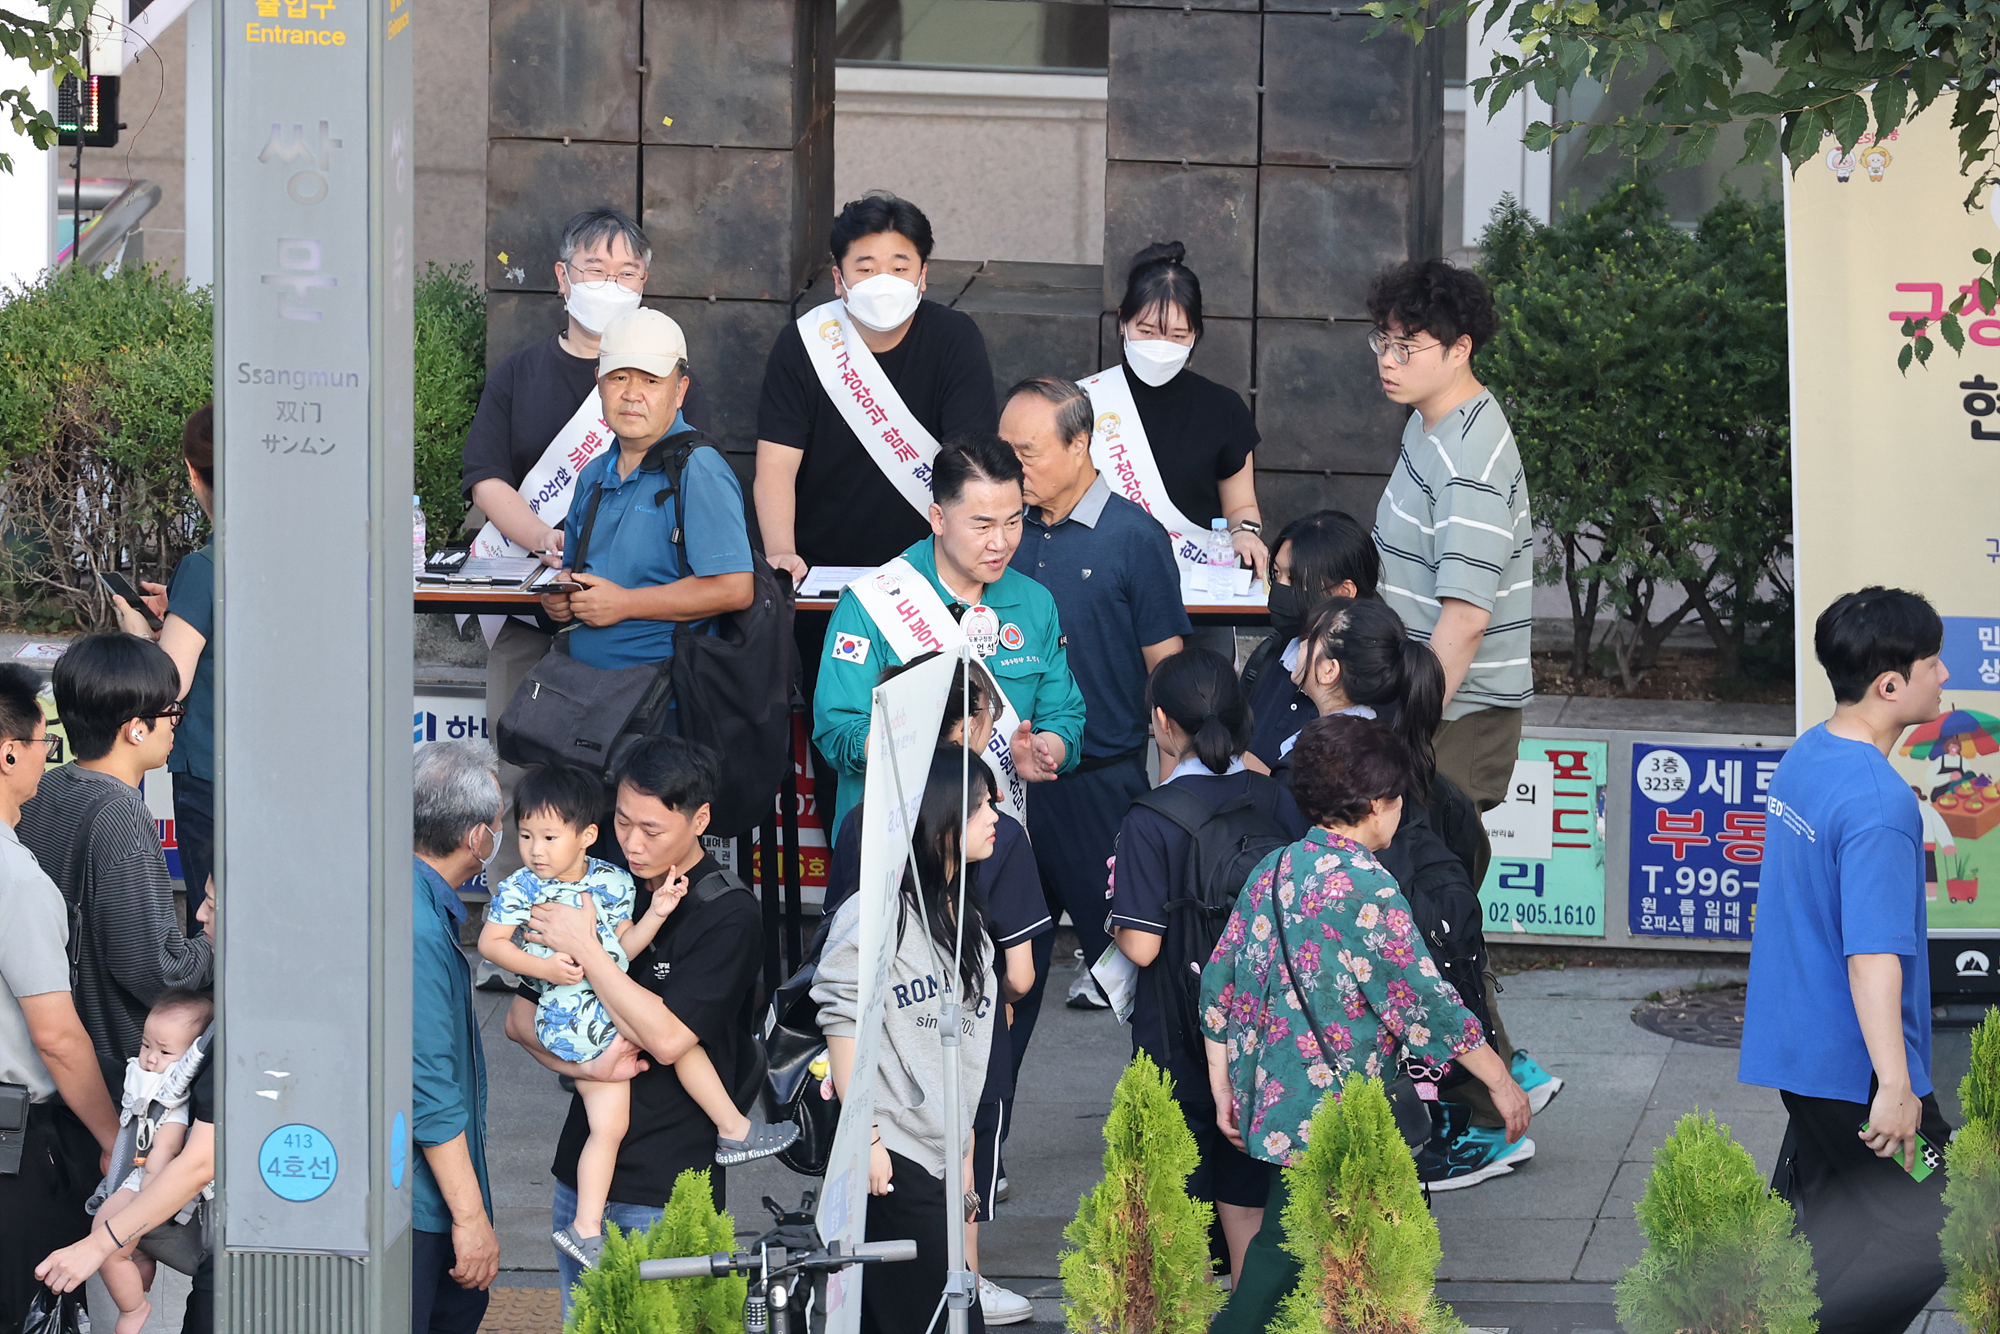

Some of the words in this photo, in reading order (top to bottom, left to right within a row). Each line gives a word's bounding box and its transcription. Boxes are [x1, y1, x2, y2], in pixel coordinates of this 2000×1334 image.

[246, 22, 346, 46] Entrance
[258, 120, 342, 321] 쌍문
[238, 362, 359, 390] Ssangmun
[276, 401, 321, 423] 双门
[836, 351, 888, 425] 구청장과
[881, 427, 920, 462] 함께
[912, 462, 933, 492] 현
[261, 433, 336, 456] サンムン
[568, 430, 603, 473] 함께
[1651, 756, 1679, 773] 3층
[1643, 777, 1687, 792] 323호
[1489, 902, 1595, 926] 02.905.1610
[1641, 916, 1695, 933] 오피스텔
[284, 1134, 313, 1148] 413
[748, 1145, 781, 1159] Kissbaby
[267, 1155, 331, 1180] 4호선
